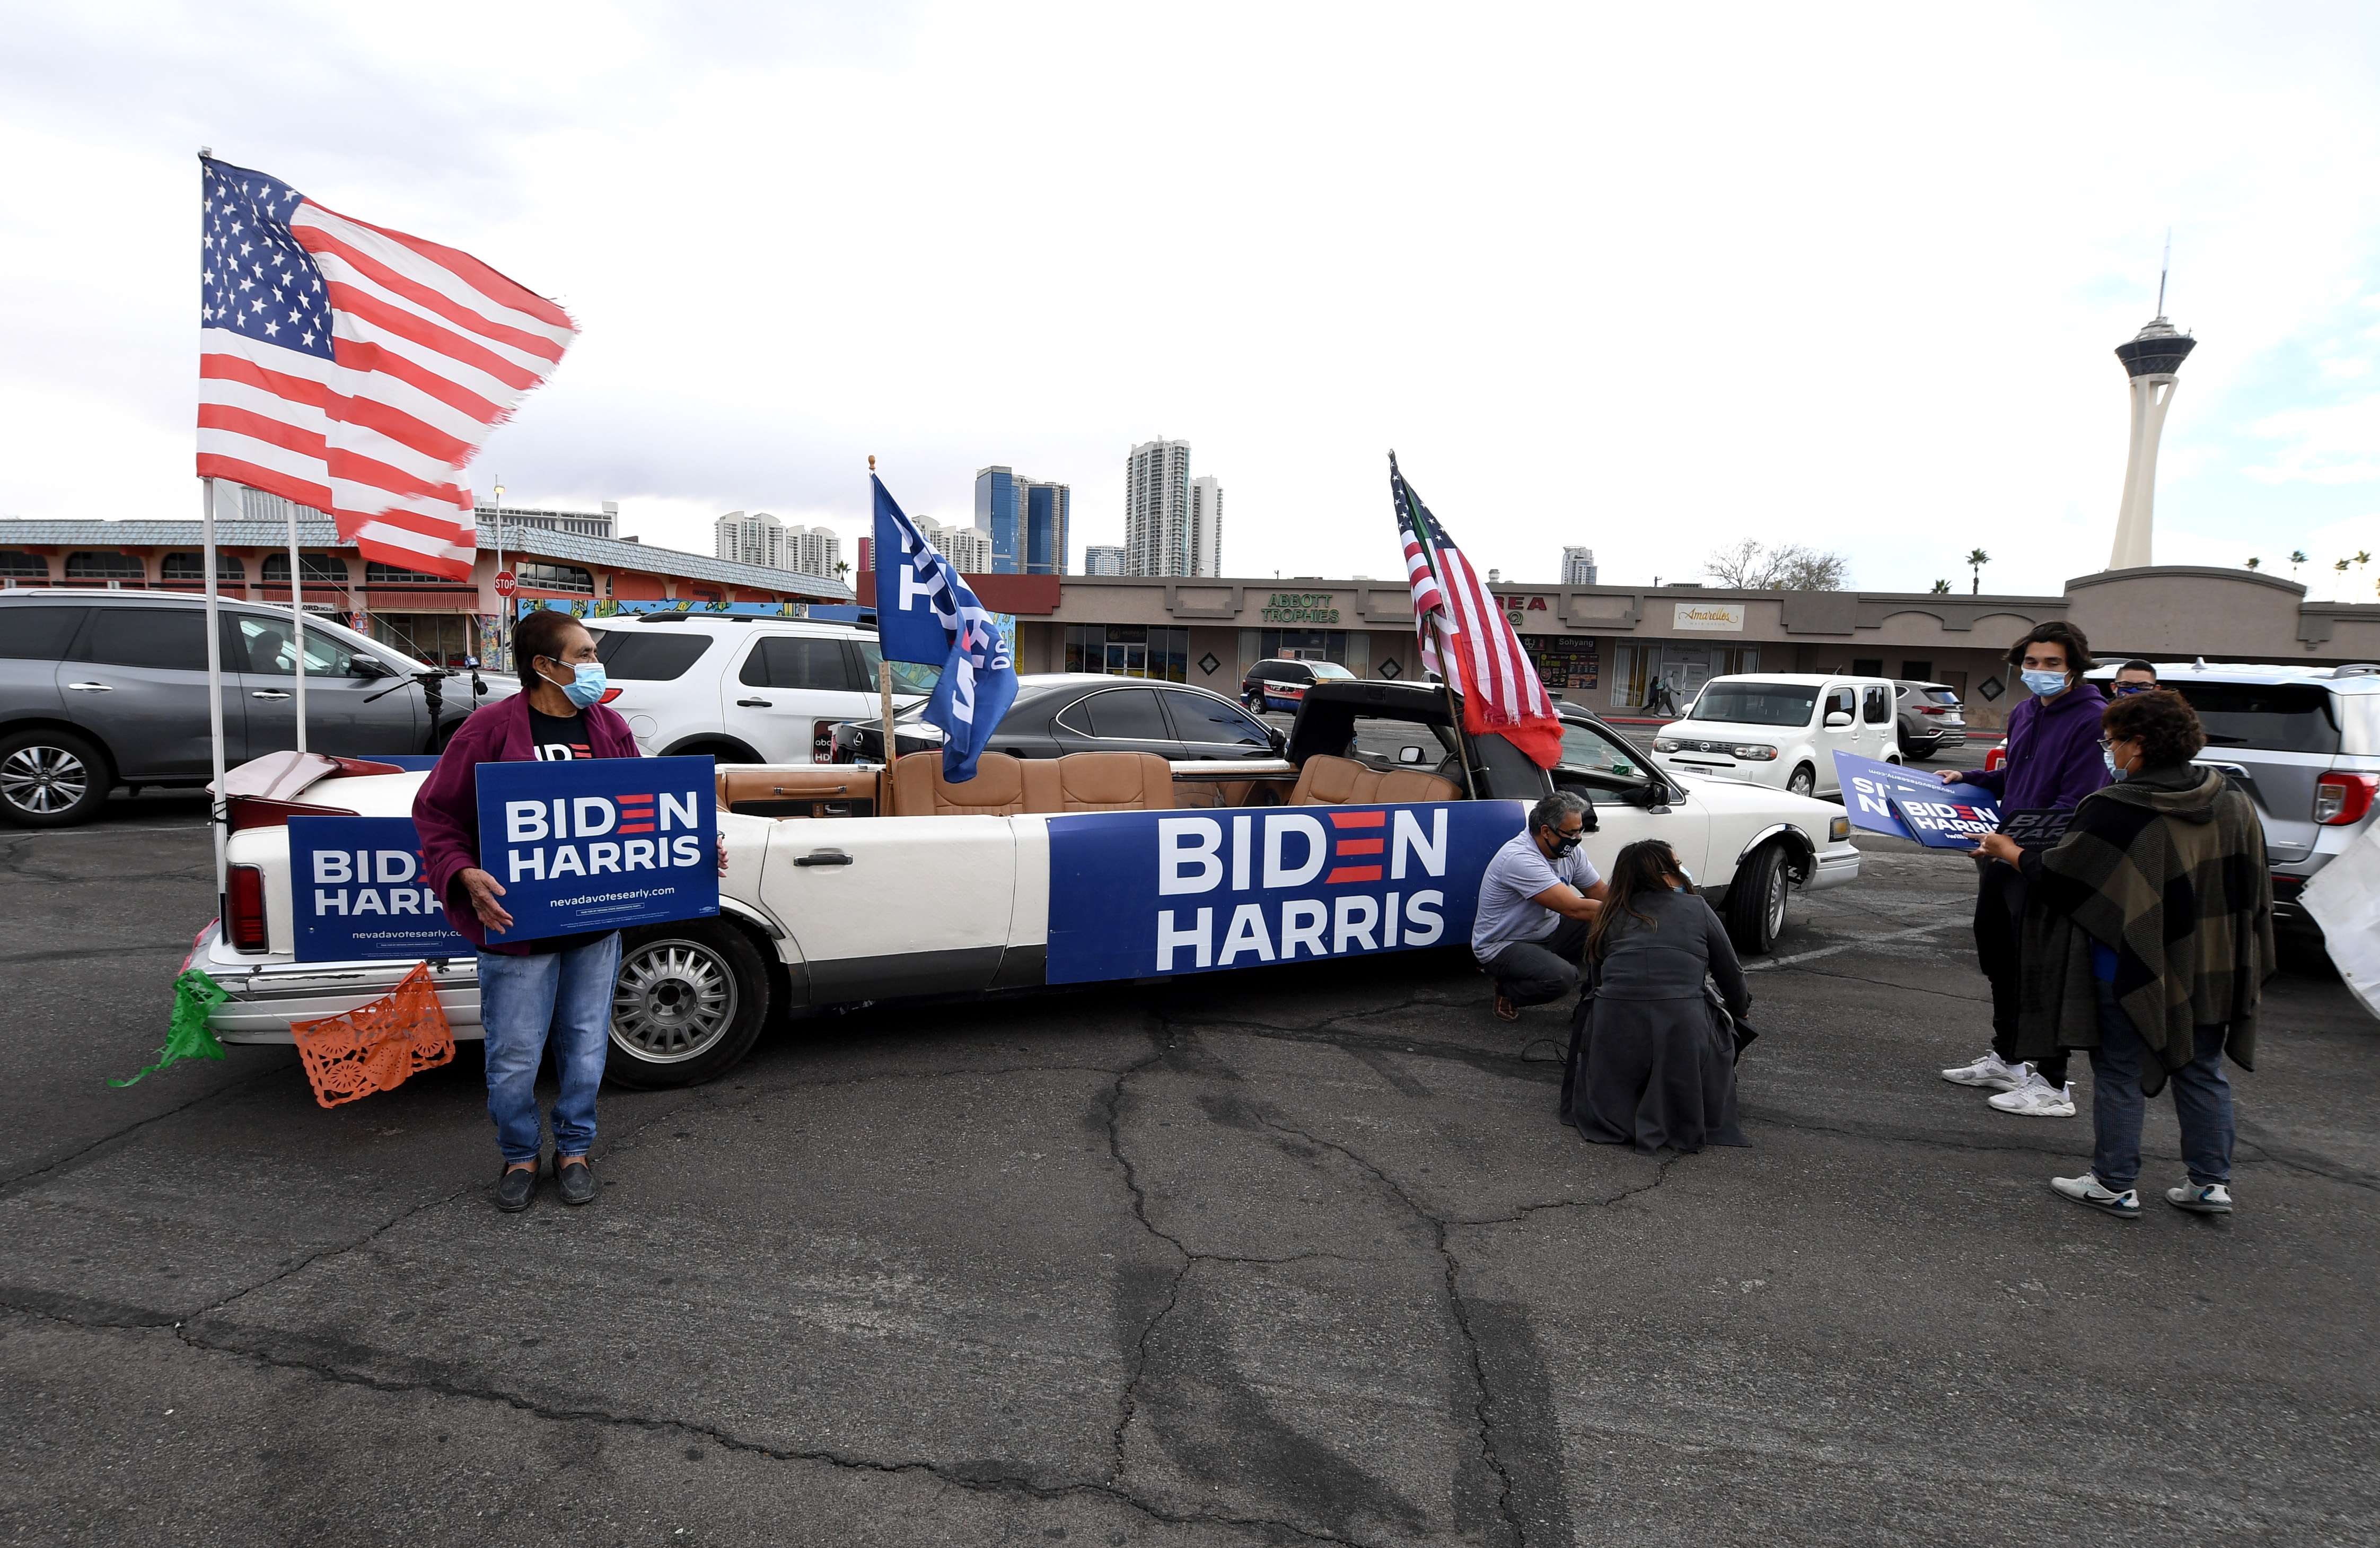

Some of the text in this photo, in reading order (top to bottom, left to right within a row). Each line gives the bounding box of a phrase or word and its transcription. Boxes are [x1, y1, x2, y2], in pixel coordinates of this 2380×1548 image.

[495, 579, 515, 589] STOP
[1268, 593, 1333, 608] ABBOTT
[1261, 608, 1340, 623] TROPHIES
[1680, 607, 1736, 623] Amarellos
[1559, 638, 1594, 648] Sohyang
[506, 791, 698, 843] BIDEN
[1901, 801, 2000, 823] BIDEN
[2008, 814, 2075, 827] BID
[508, 835, 701, 882] HARRIS
[1158, 808, 1448, 896] BIDEN
[313, 850, 428, 884] BID
[314, 888, 444, 916] HAR
[550, 887, 675, 908] nevadavotesearly.com
[352, 929, 462, 939] nevadavotesearly.c
[1156, 889, 1445, 971] HARRIS
